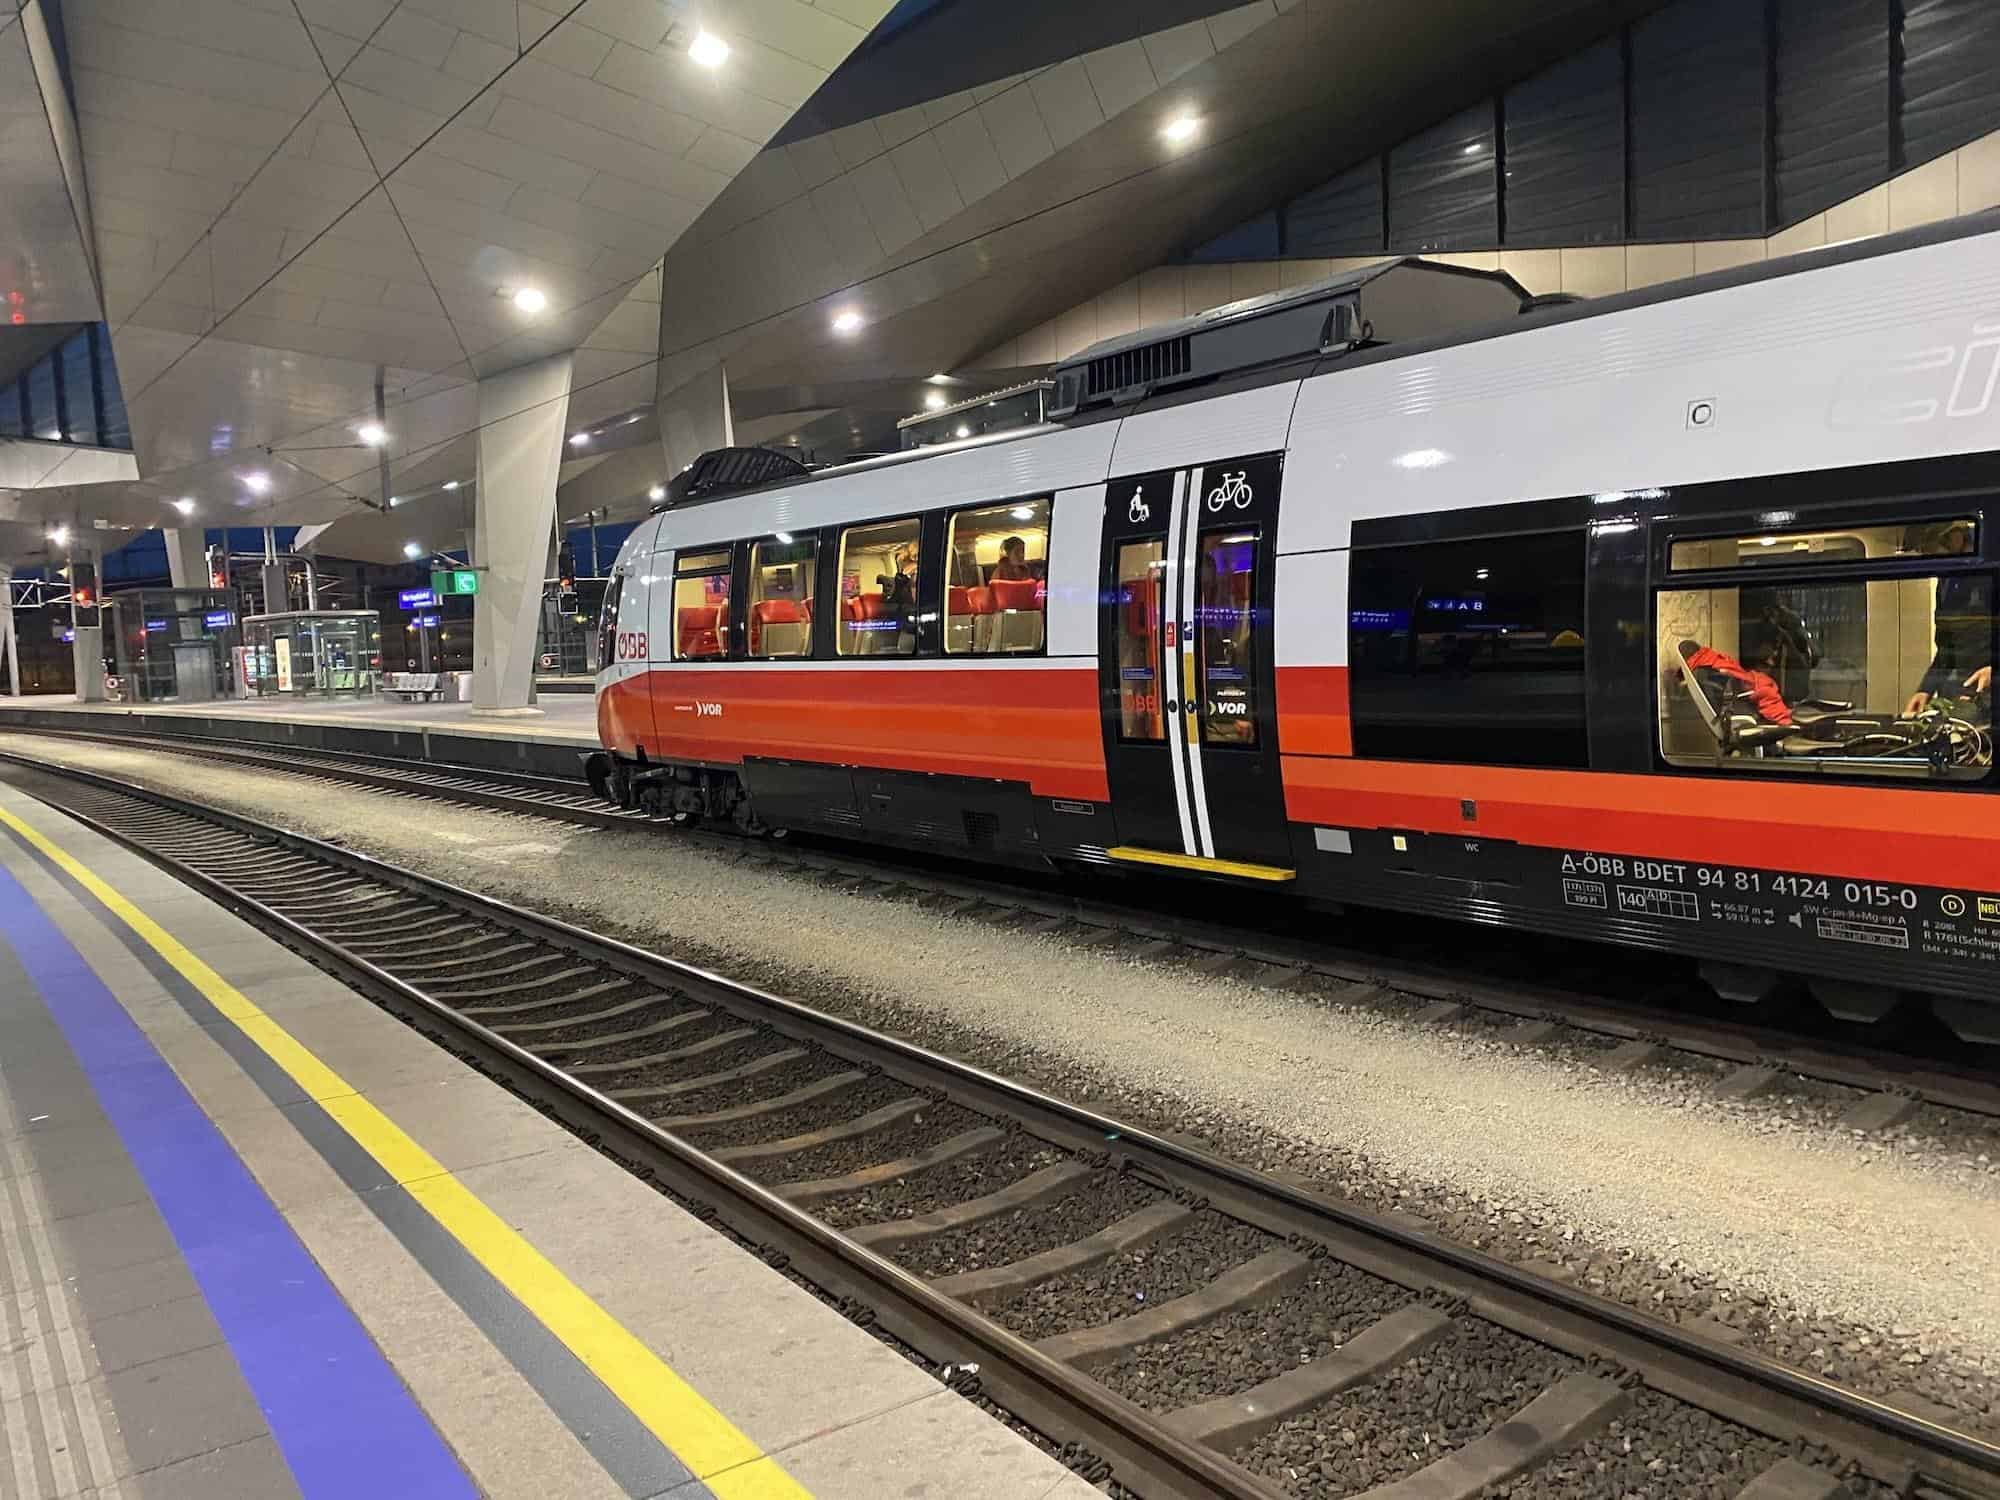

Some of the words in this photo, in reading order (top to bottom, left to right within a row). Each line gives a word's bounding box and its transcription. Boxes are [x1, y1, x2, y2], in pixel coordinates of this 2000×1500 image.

[1217, 702, 1247, 715] VOR
[1464, 842, 1480, 852] WC
[1562, 852, 1625, 876] A-ÖBB
[1634, 861, 1687, 883] BDET
[1697, 868, 1726, 888] 94
[1735, 872, 1760, 892] 81
[1772, 876, 1831, 900] 4124
[1844, 883, 1917, 909] 015-0
[1621, 892, 1645, 907] 140
